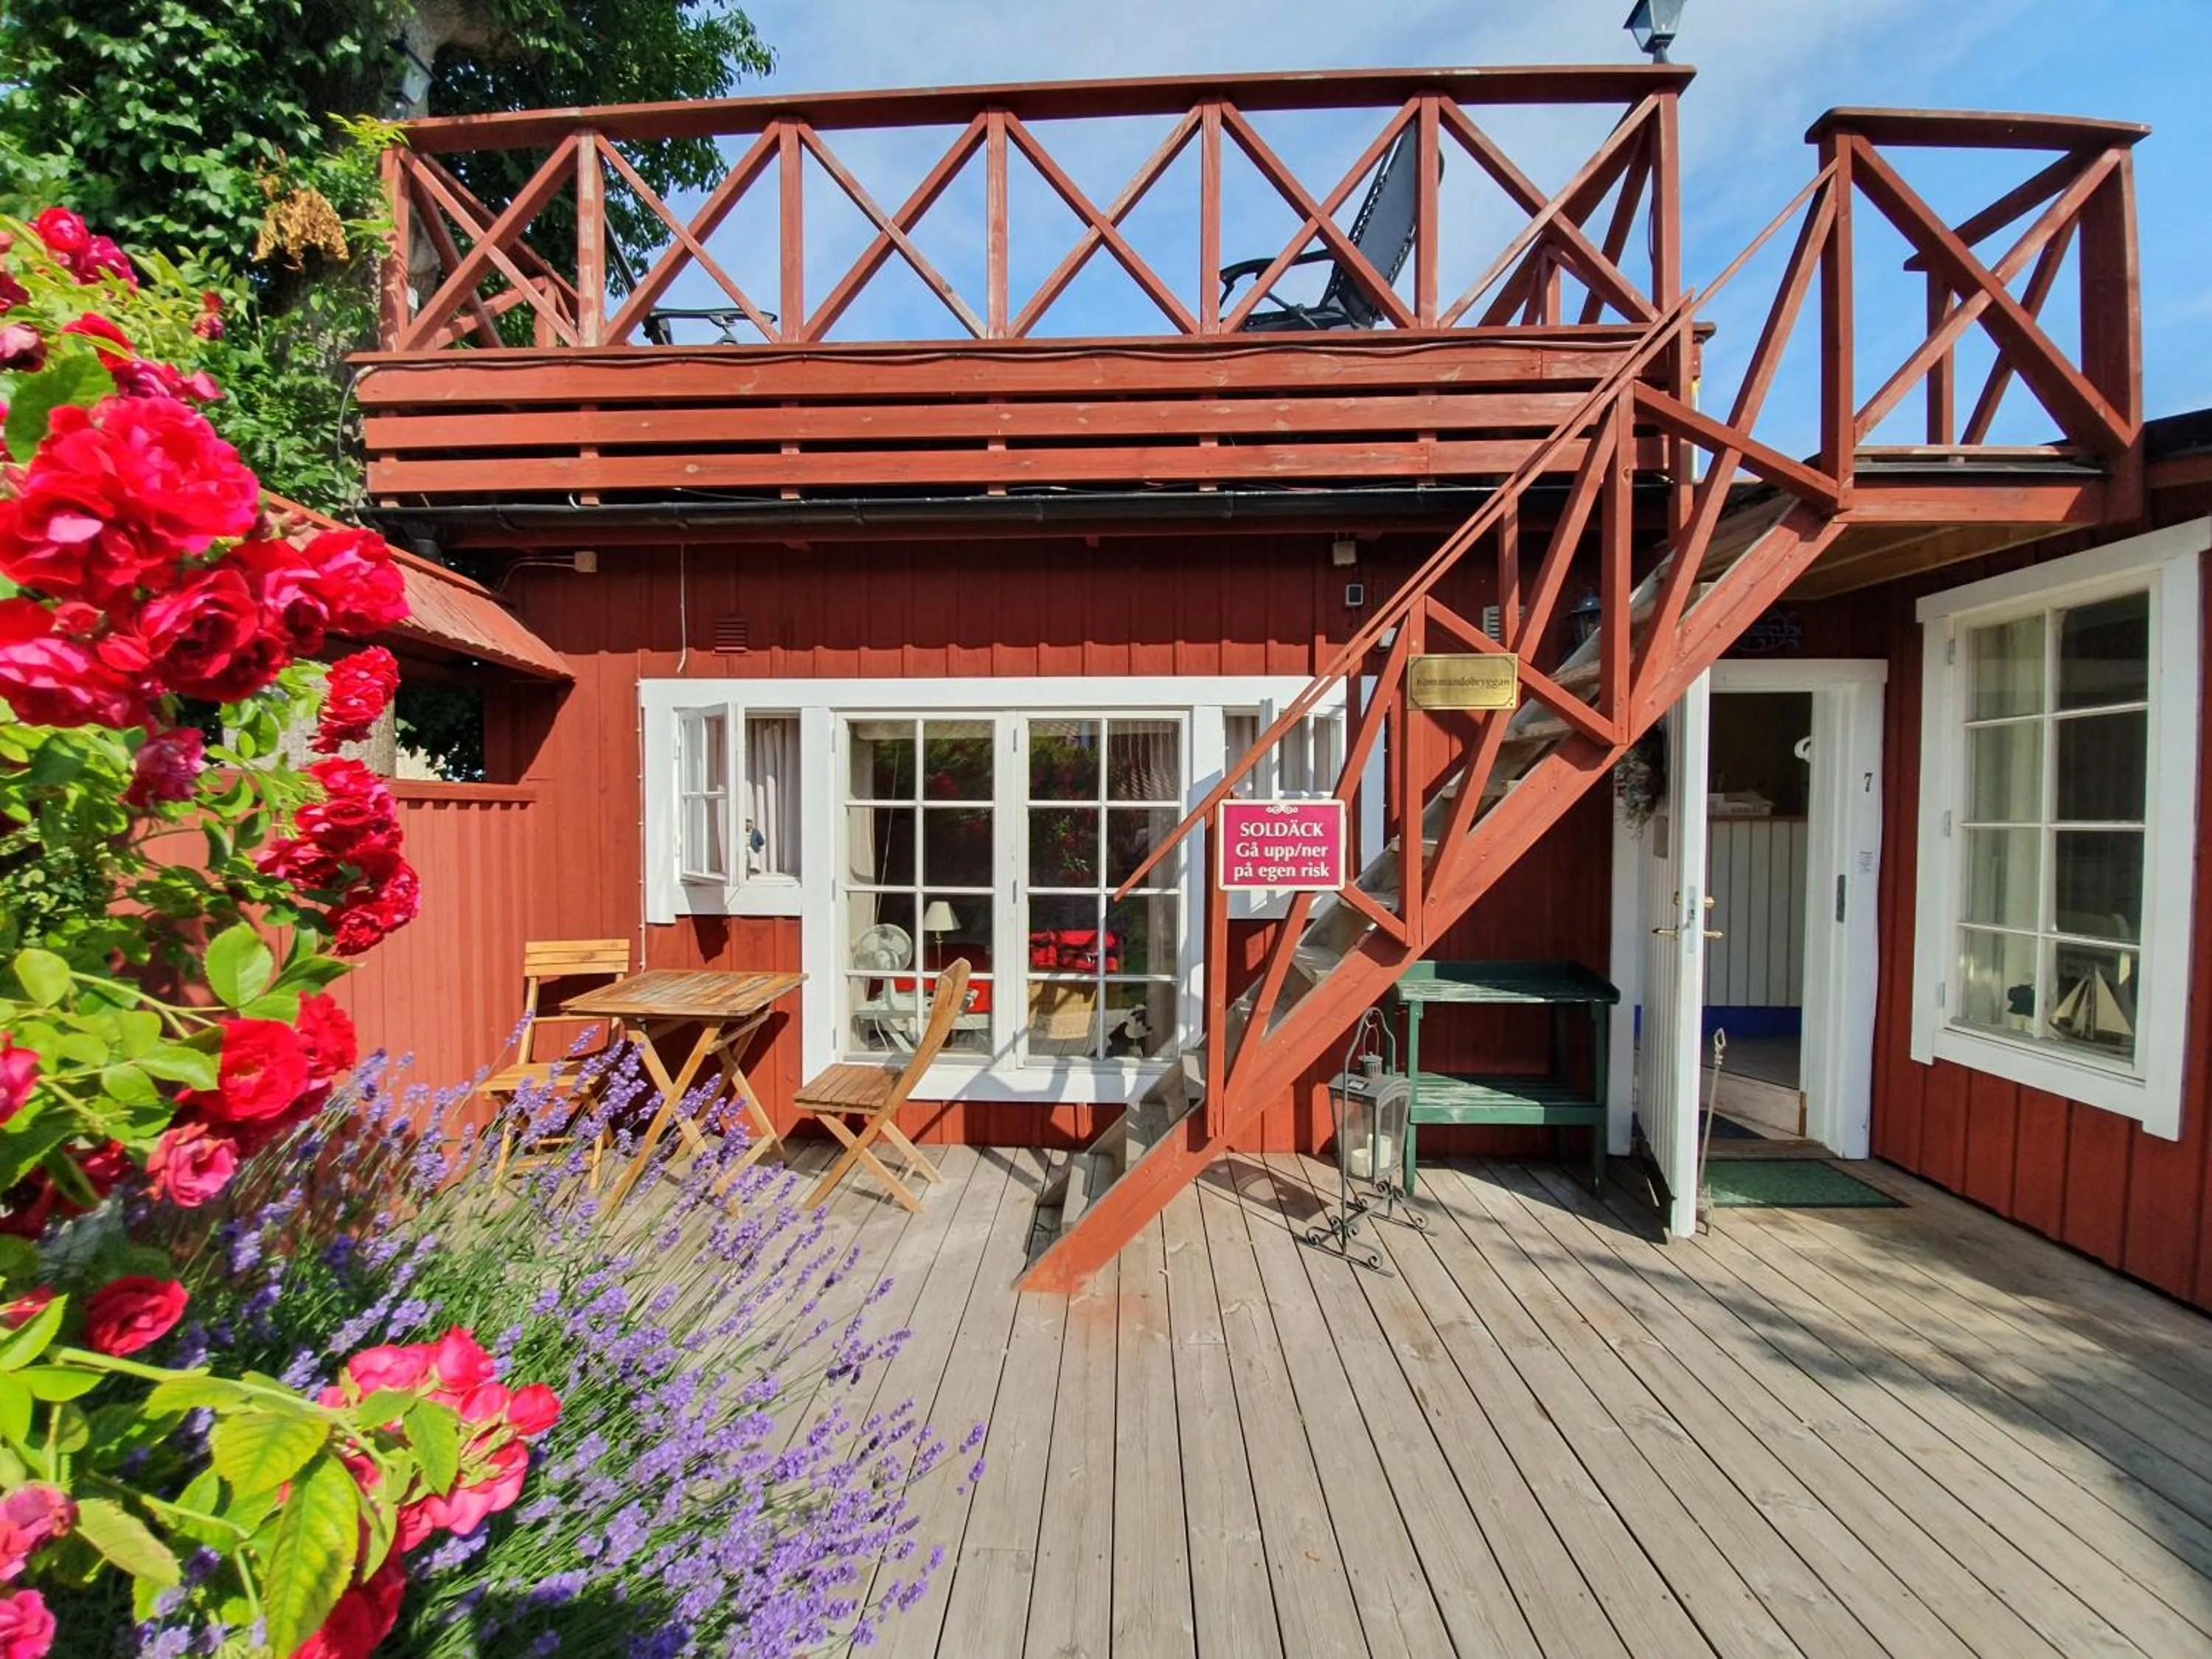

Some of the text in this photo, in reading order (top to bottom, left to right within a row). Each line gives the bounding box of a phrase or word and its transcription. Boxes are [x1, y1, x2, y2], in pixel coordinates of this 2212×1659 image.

[1864, 772, 1873, 793] 7
[1239, 819, 1324, 838] SOLDÄCK
[1235, 841, 1329, 861] Gå upp/ner
[1234, 861, 1330, 882] på egen risk
